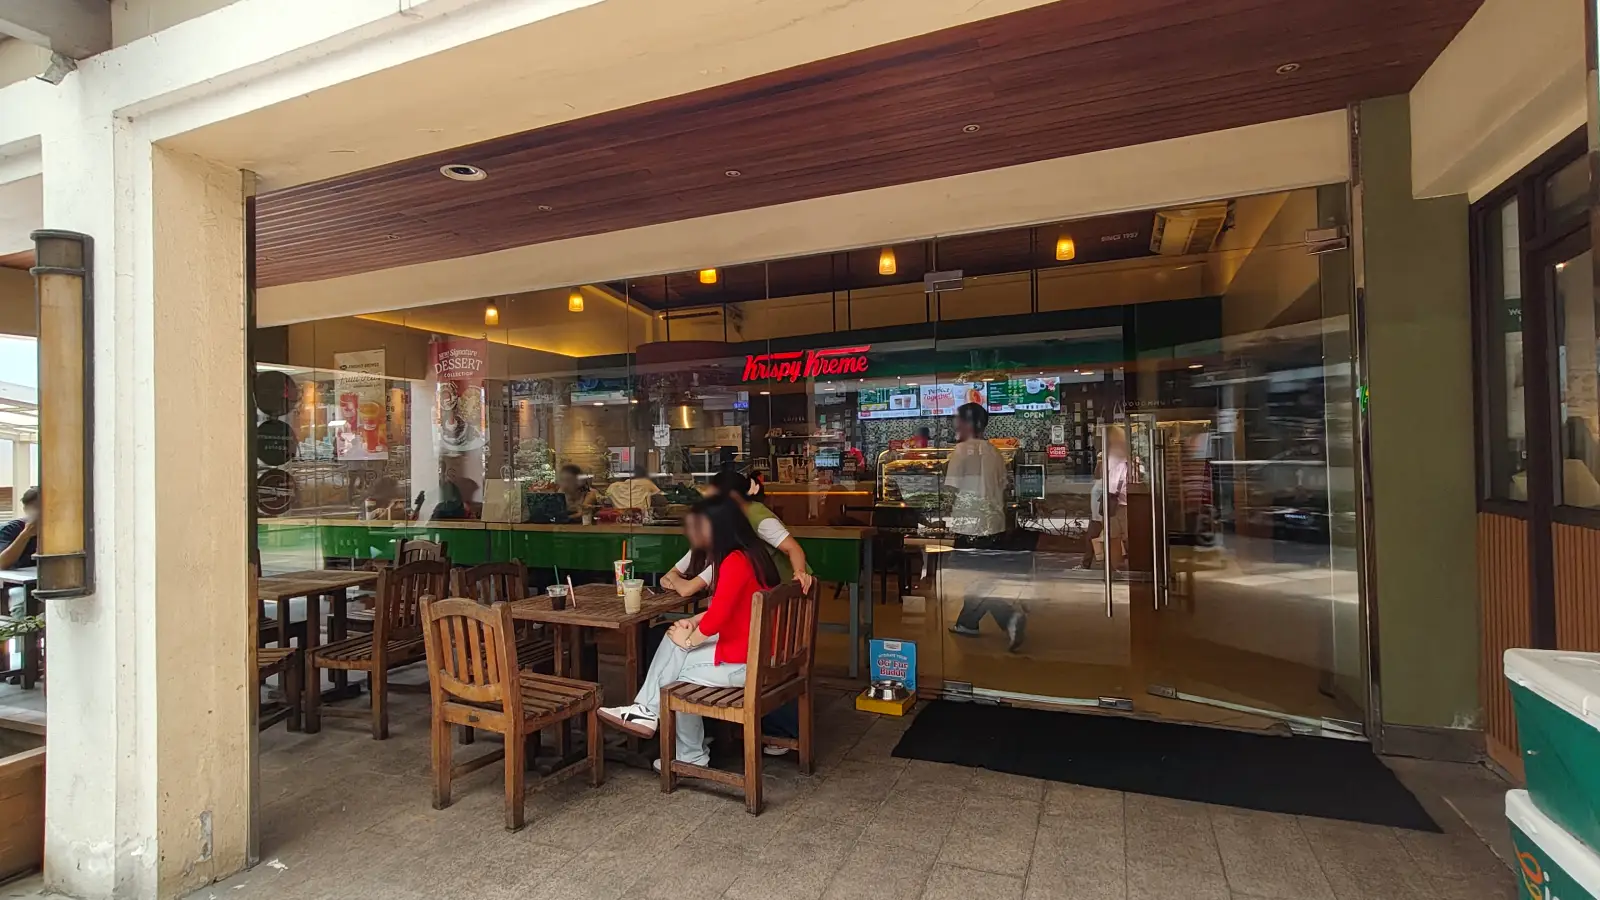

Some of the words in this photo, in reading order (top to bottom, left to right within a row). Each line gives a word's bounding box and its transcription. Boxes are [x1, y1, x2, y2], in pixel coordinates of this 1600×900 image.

[449, 348, 478, 357] Signature
[434, 357, 483, 374] DESSERT
[742, 350, 803, 382] Krispy
[803, 344, 871, 376] Kreme
[927, 386, 950, 396] Perfect
[1023, 411, 1045, 419] OPEN
[877, 658, 891, 668] OG
[893, 660, 908, 669] Fur
[880, 668, 906, 680] Buddy
